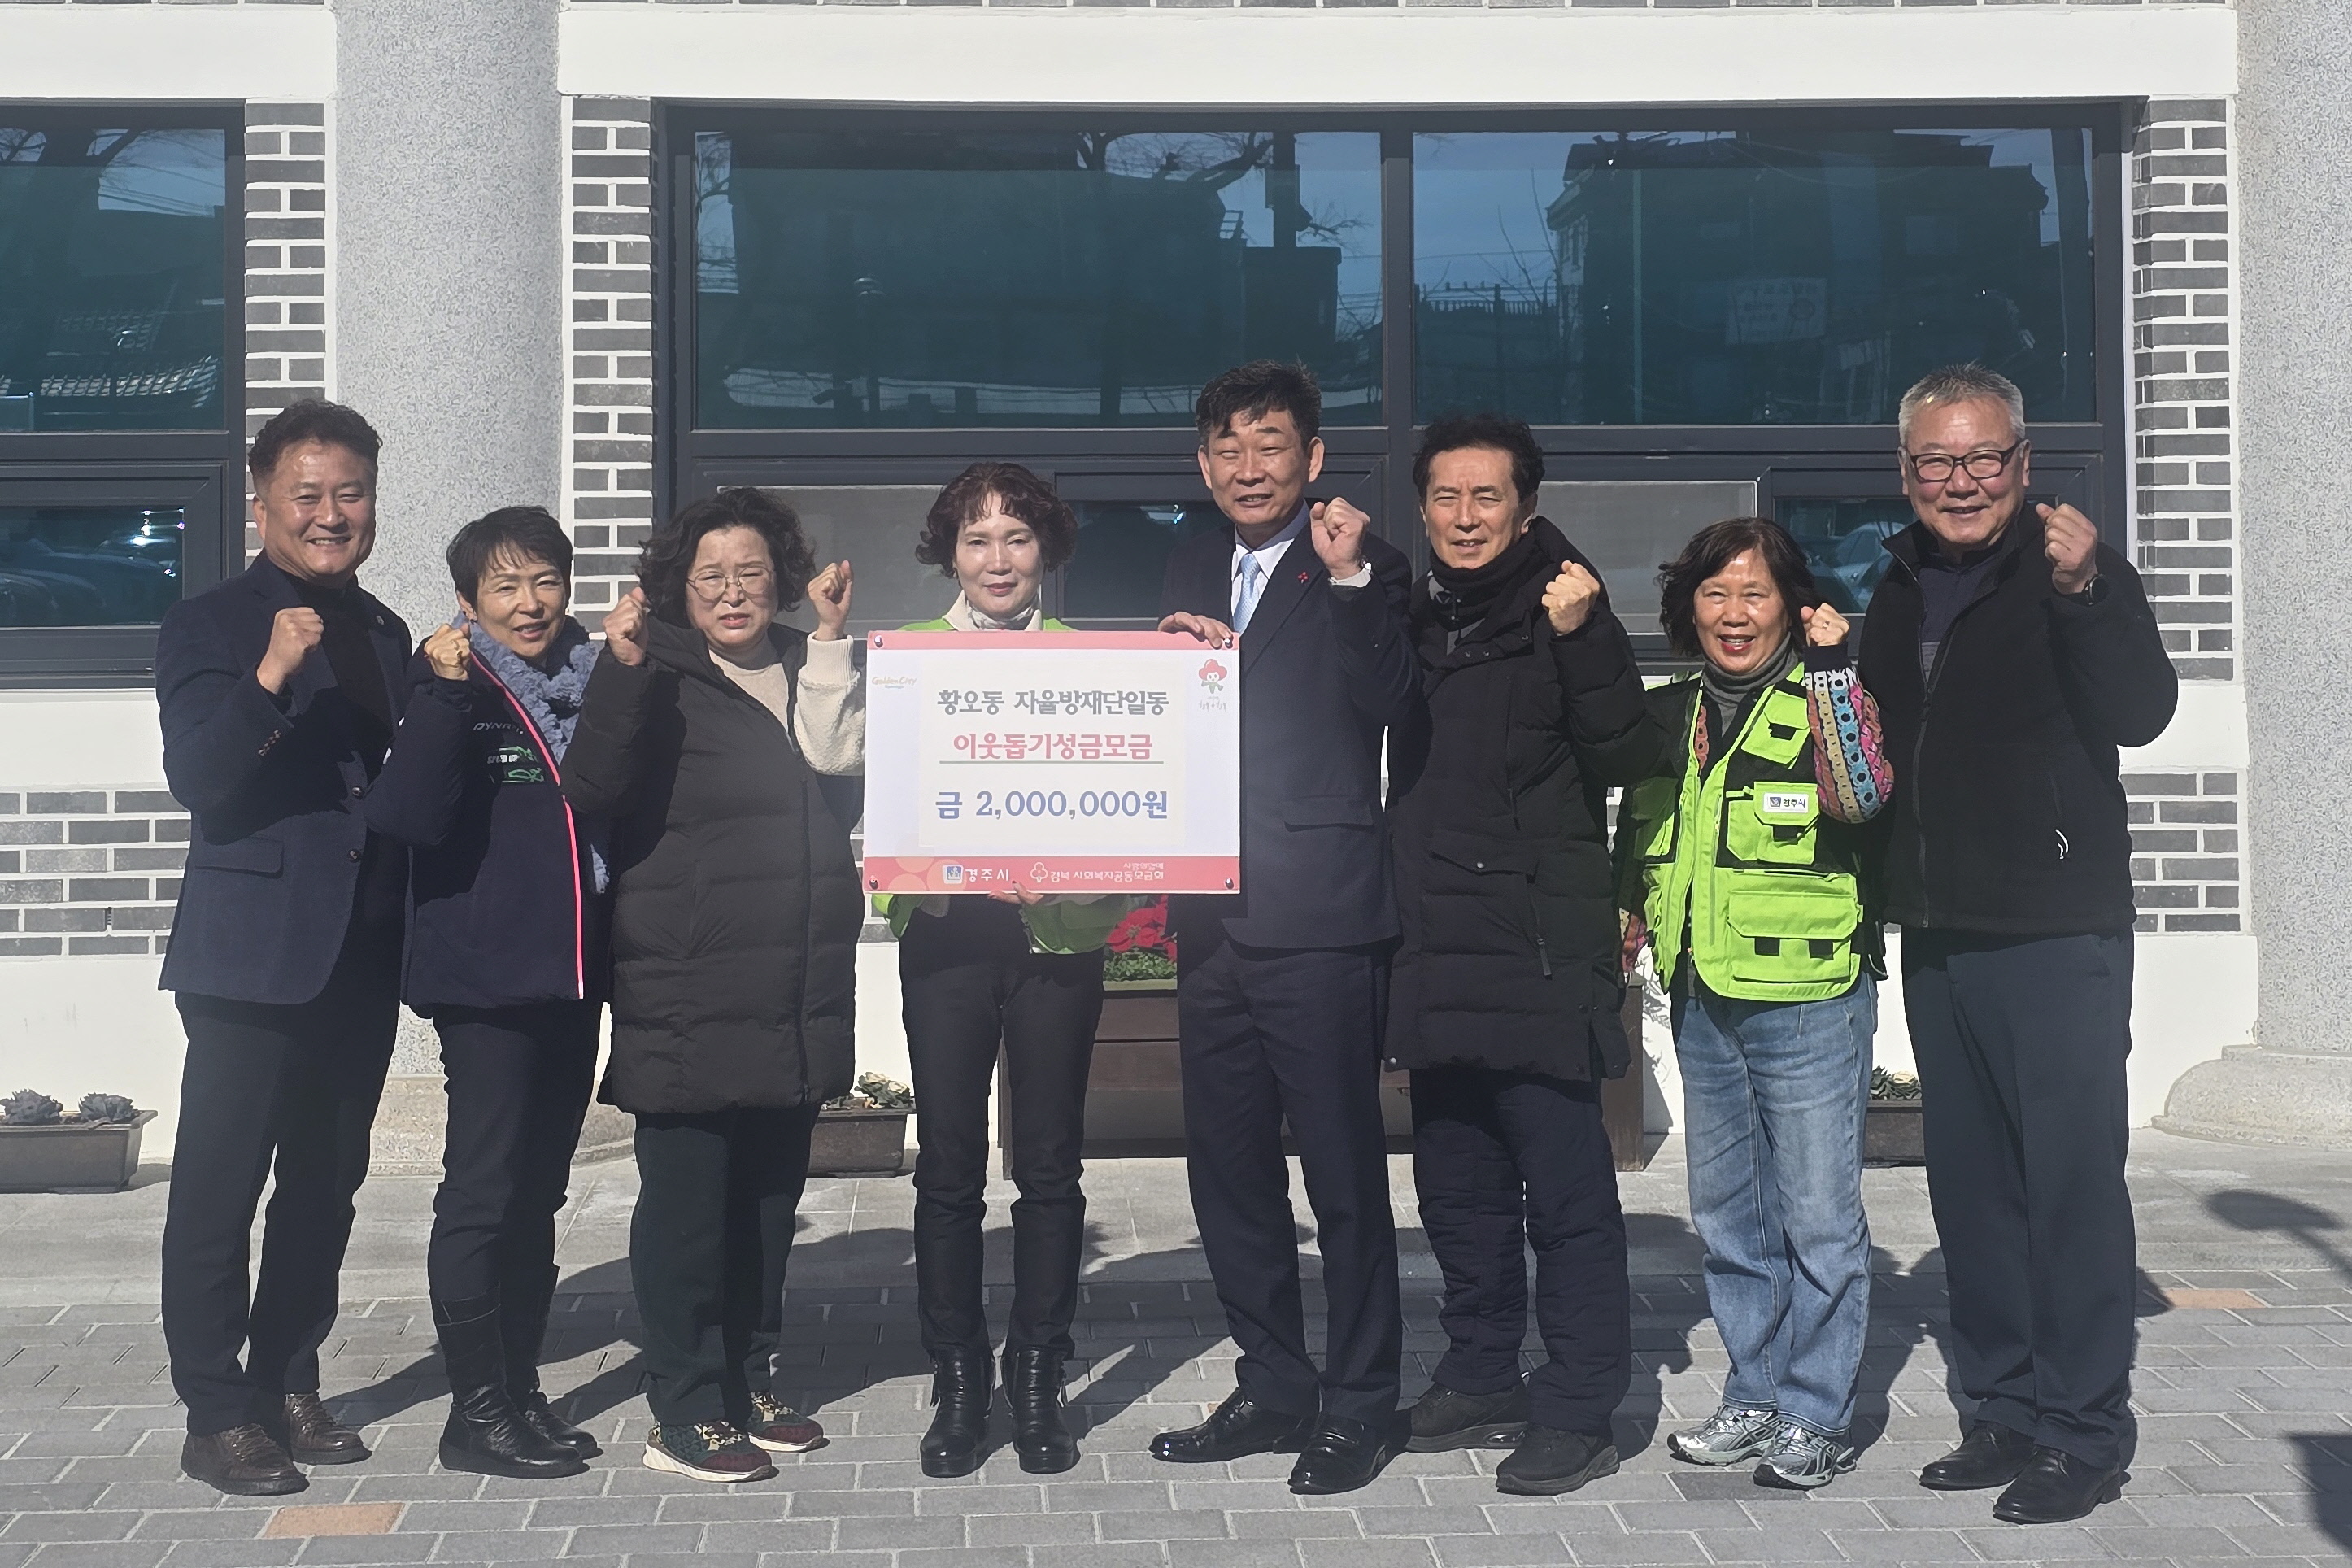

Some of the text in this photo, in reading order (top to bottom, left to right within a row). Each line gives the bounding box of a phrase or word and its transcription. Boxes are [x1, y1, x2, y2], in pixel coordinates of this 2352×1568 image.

[937, 690, 1004, 715] 황오동
[1014, 690, 1169, 715] 자율방재단일동
[953, 732, 1152, 760] 이웃돕기성금모금
[935, 791, 1168, 820] 금 2,000,000원
[965, 868, 1009, 882] 경주시
[1074, 871, 1164, 882] 사회복지공동모금회
